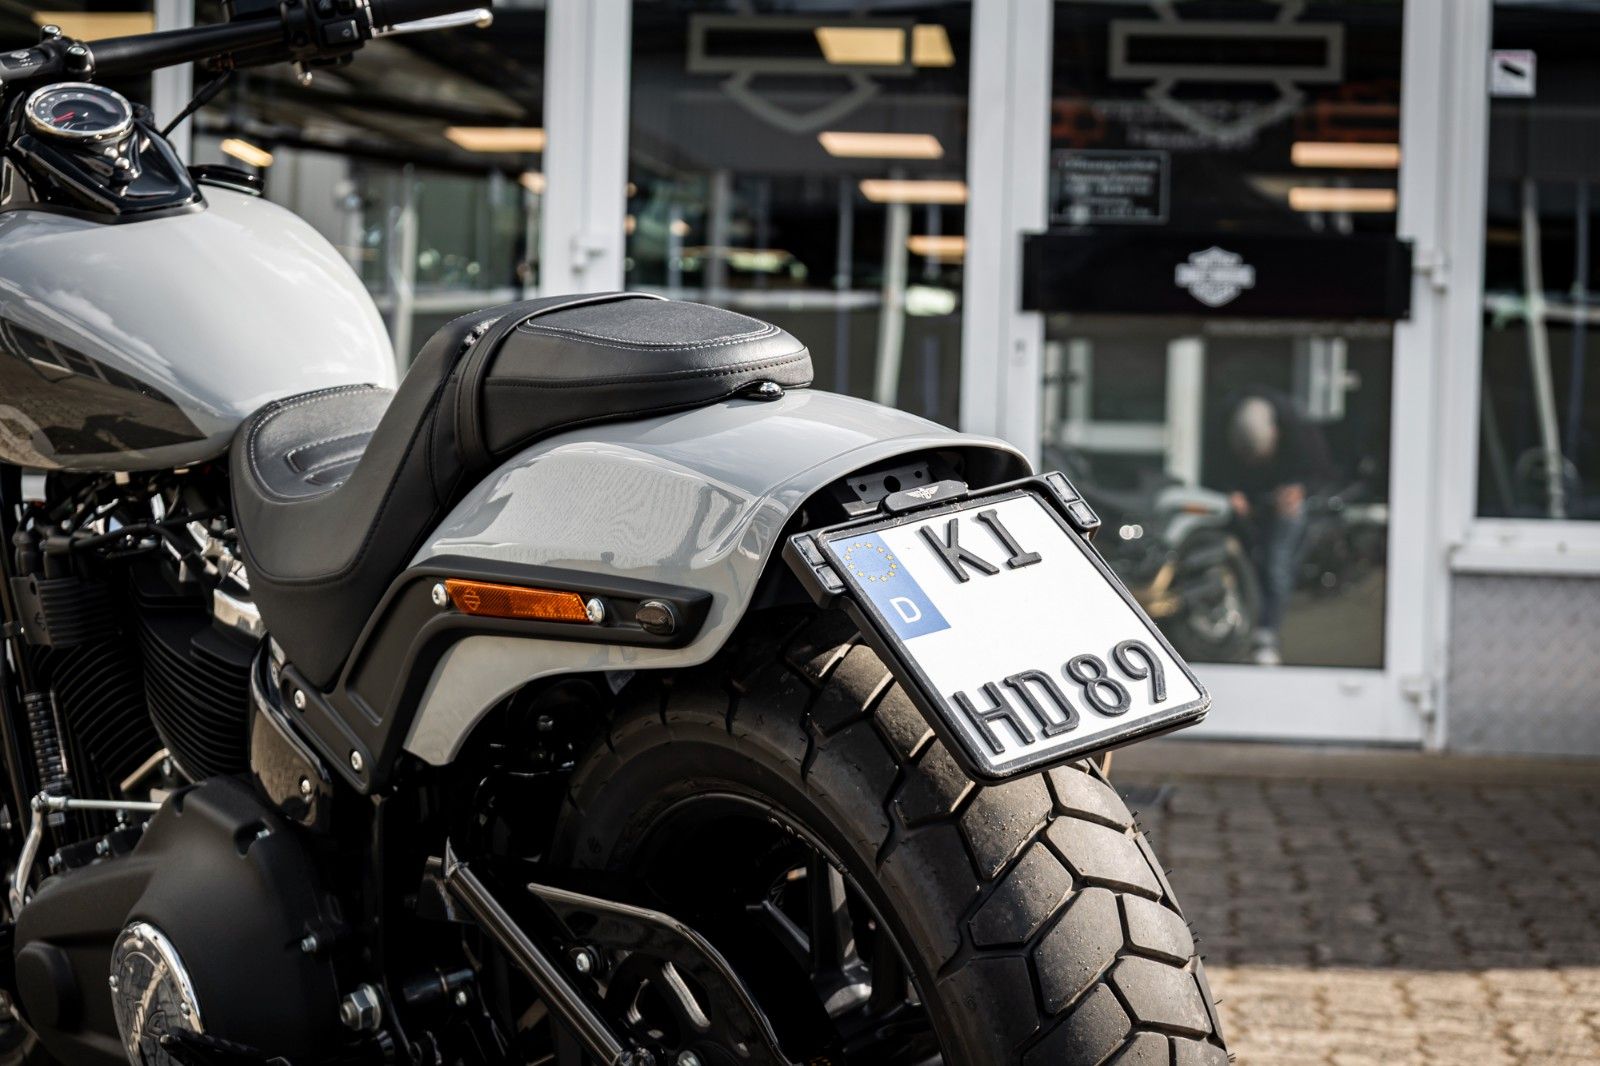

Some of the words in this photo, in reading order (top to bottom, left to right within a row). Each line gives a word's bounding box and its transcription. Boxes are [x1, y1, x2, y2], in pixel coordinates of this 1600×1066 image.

[920, 508, 1042, 583] KI
[889, 597, 922, 624] D
[952, 639, 1167, 754] HD89
